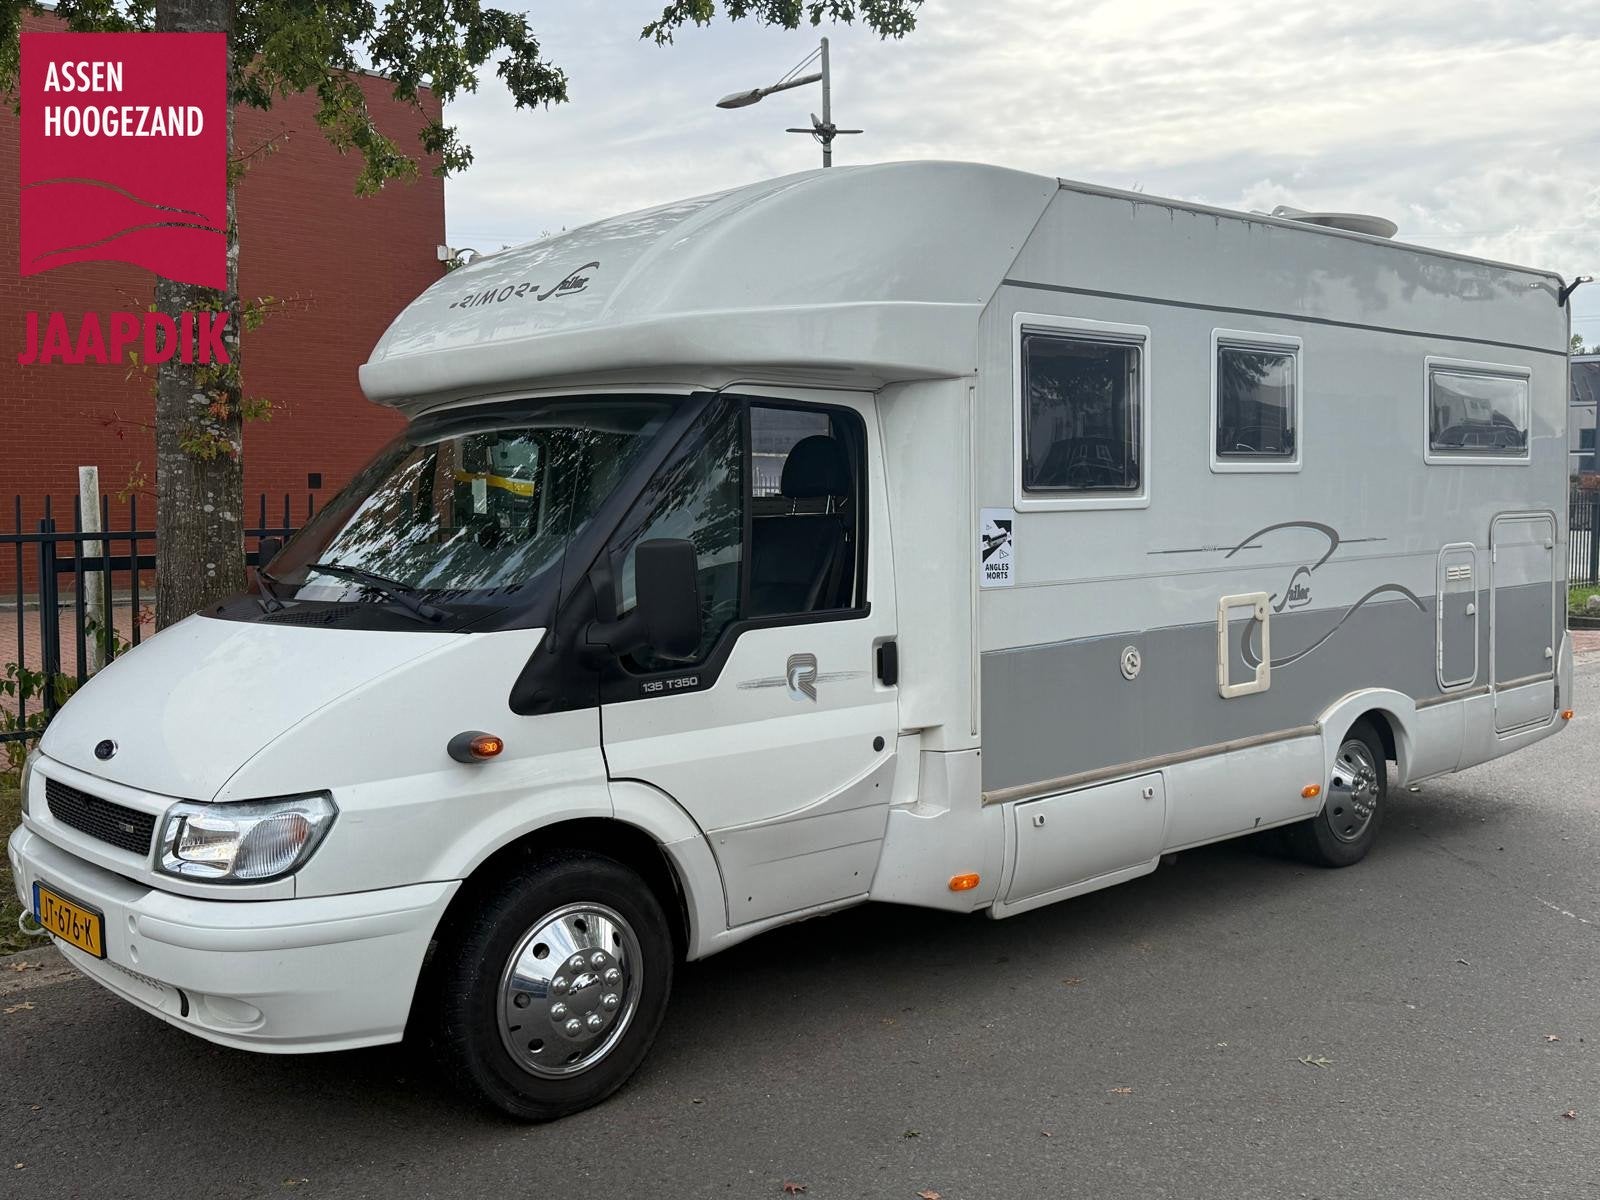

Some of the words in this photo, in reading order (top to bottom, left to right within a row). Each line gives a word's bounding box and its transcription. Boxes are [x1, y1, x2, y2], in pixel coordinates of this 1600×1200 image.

[459, 282, 531, 308] RIMOR
[985, 563, 1009, 572] ANGLES
[986, 571, 1008, 580] MORTS
[642, 680, 663, 693] 135
[667, 676, 698, 689] T350
[43, 895, 95, 949] JT-676-K
